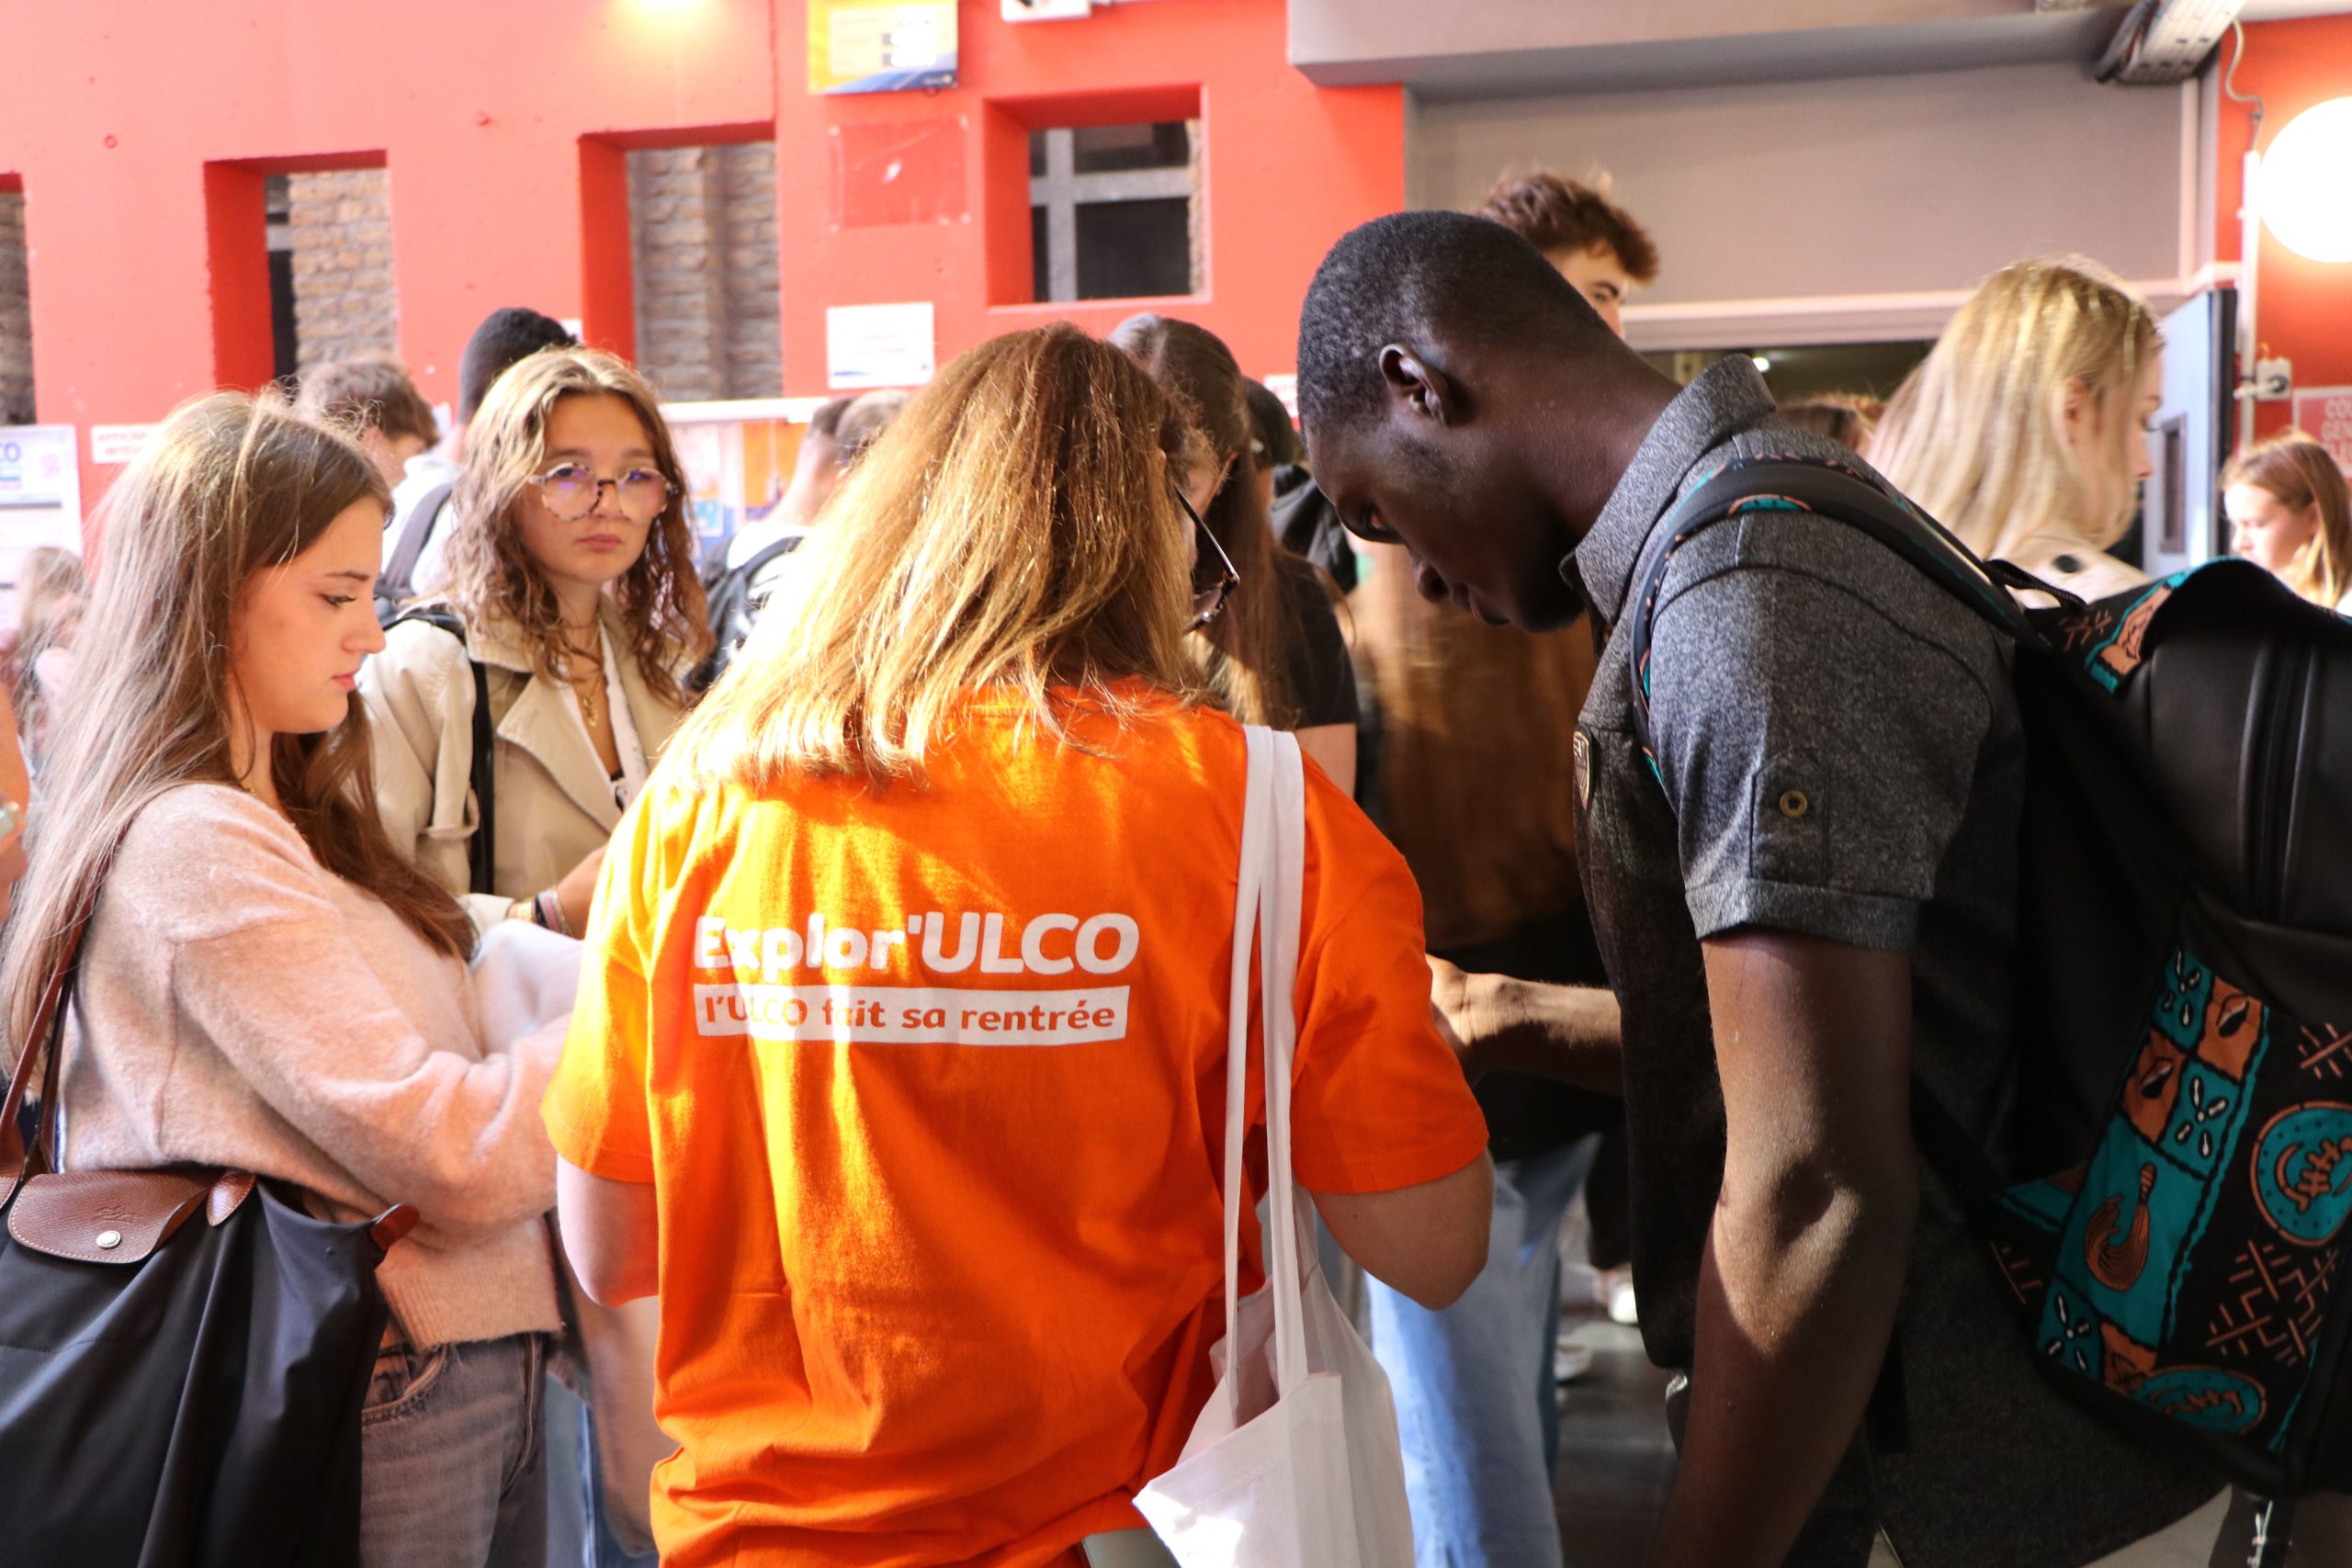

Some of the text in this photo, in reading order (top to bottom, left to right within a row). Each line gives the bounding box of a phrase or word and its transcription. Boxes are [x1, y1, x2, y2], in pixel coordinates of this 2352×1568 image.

[695, 911, 1140, 983] Explor'ULCO
[705, 996, 1115, 1032] l'ULCO fait sa rentrée
